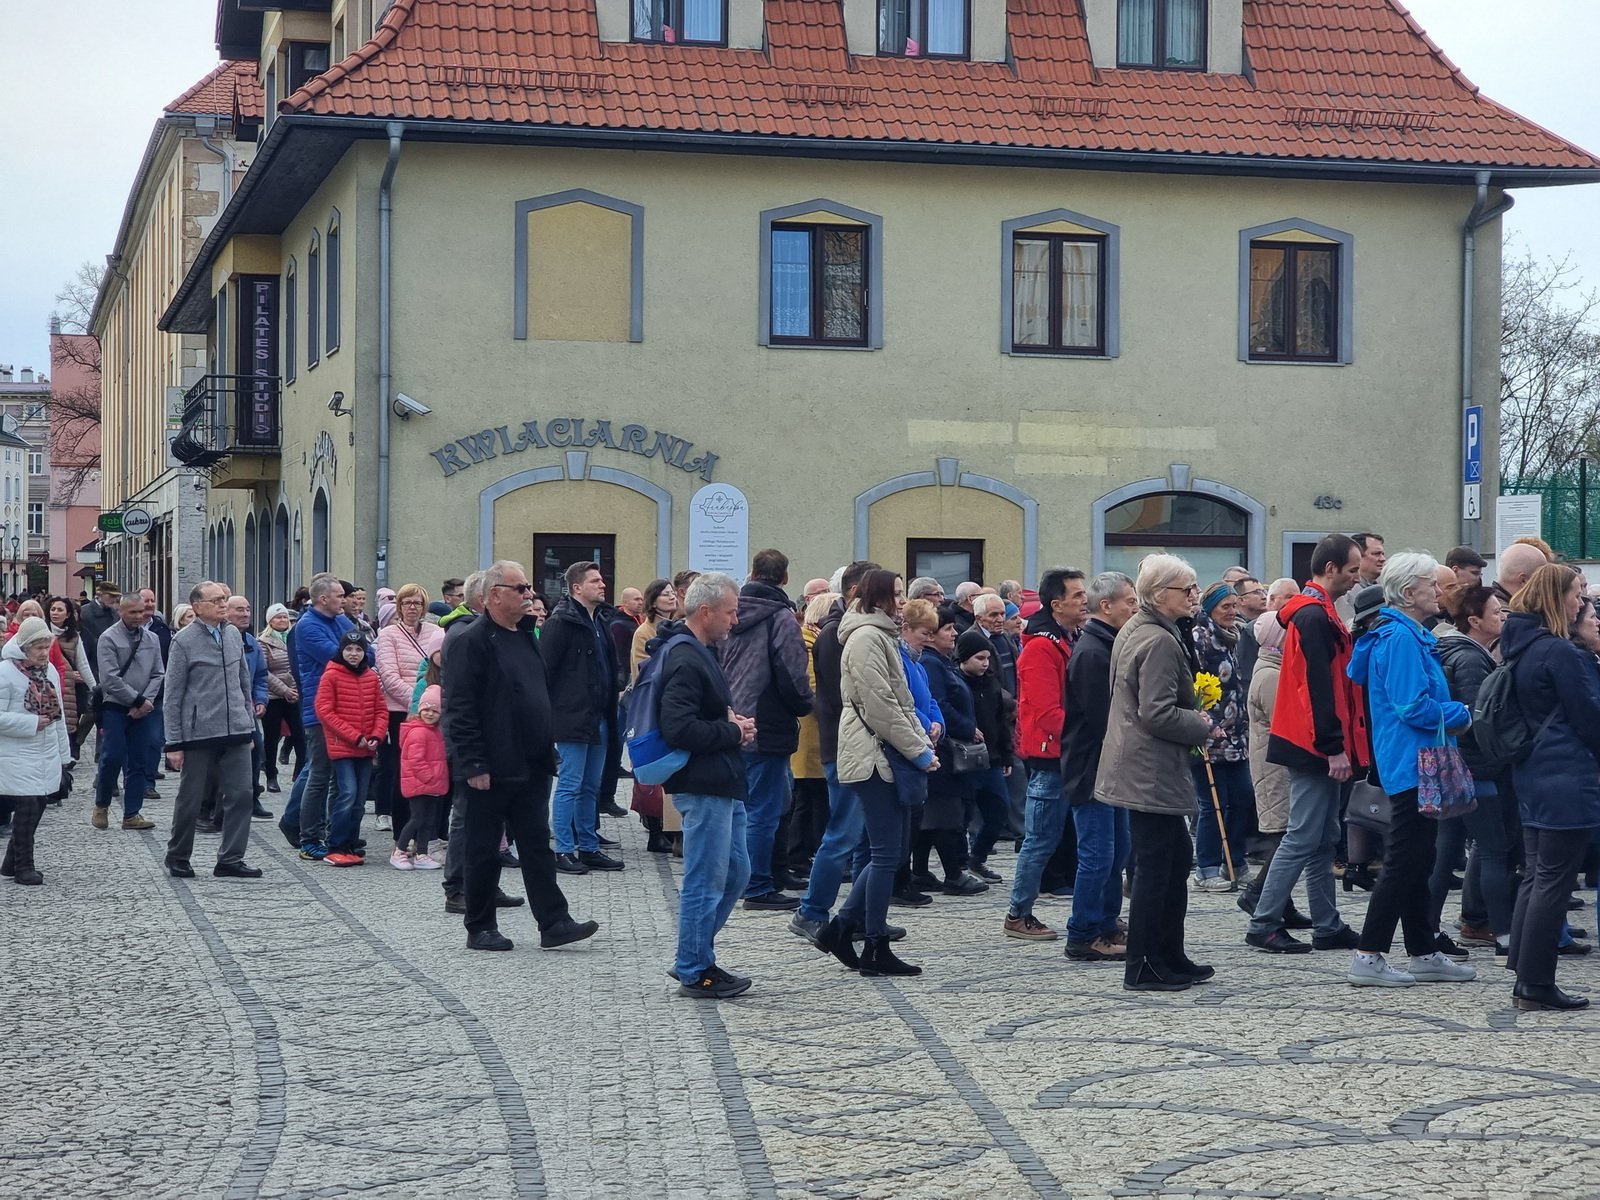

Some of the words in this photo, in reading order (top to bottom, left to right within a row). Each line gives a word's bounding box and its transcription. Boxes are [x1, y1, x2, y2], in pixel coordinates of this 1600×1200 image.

[254, 284, 270, 360] PILATES
[430, 418, 719, 482] KWIACIARNIA
[1467, 413, 1478, 460] P
[102, 517, 122, 525] zab
